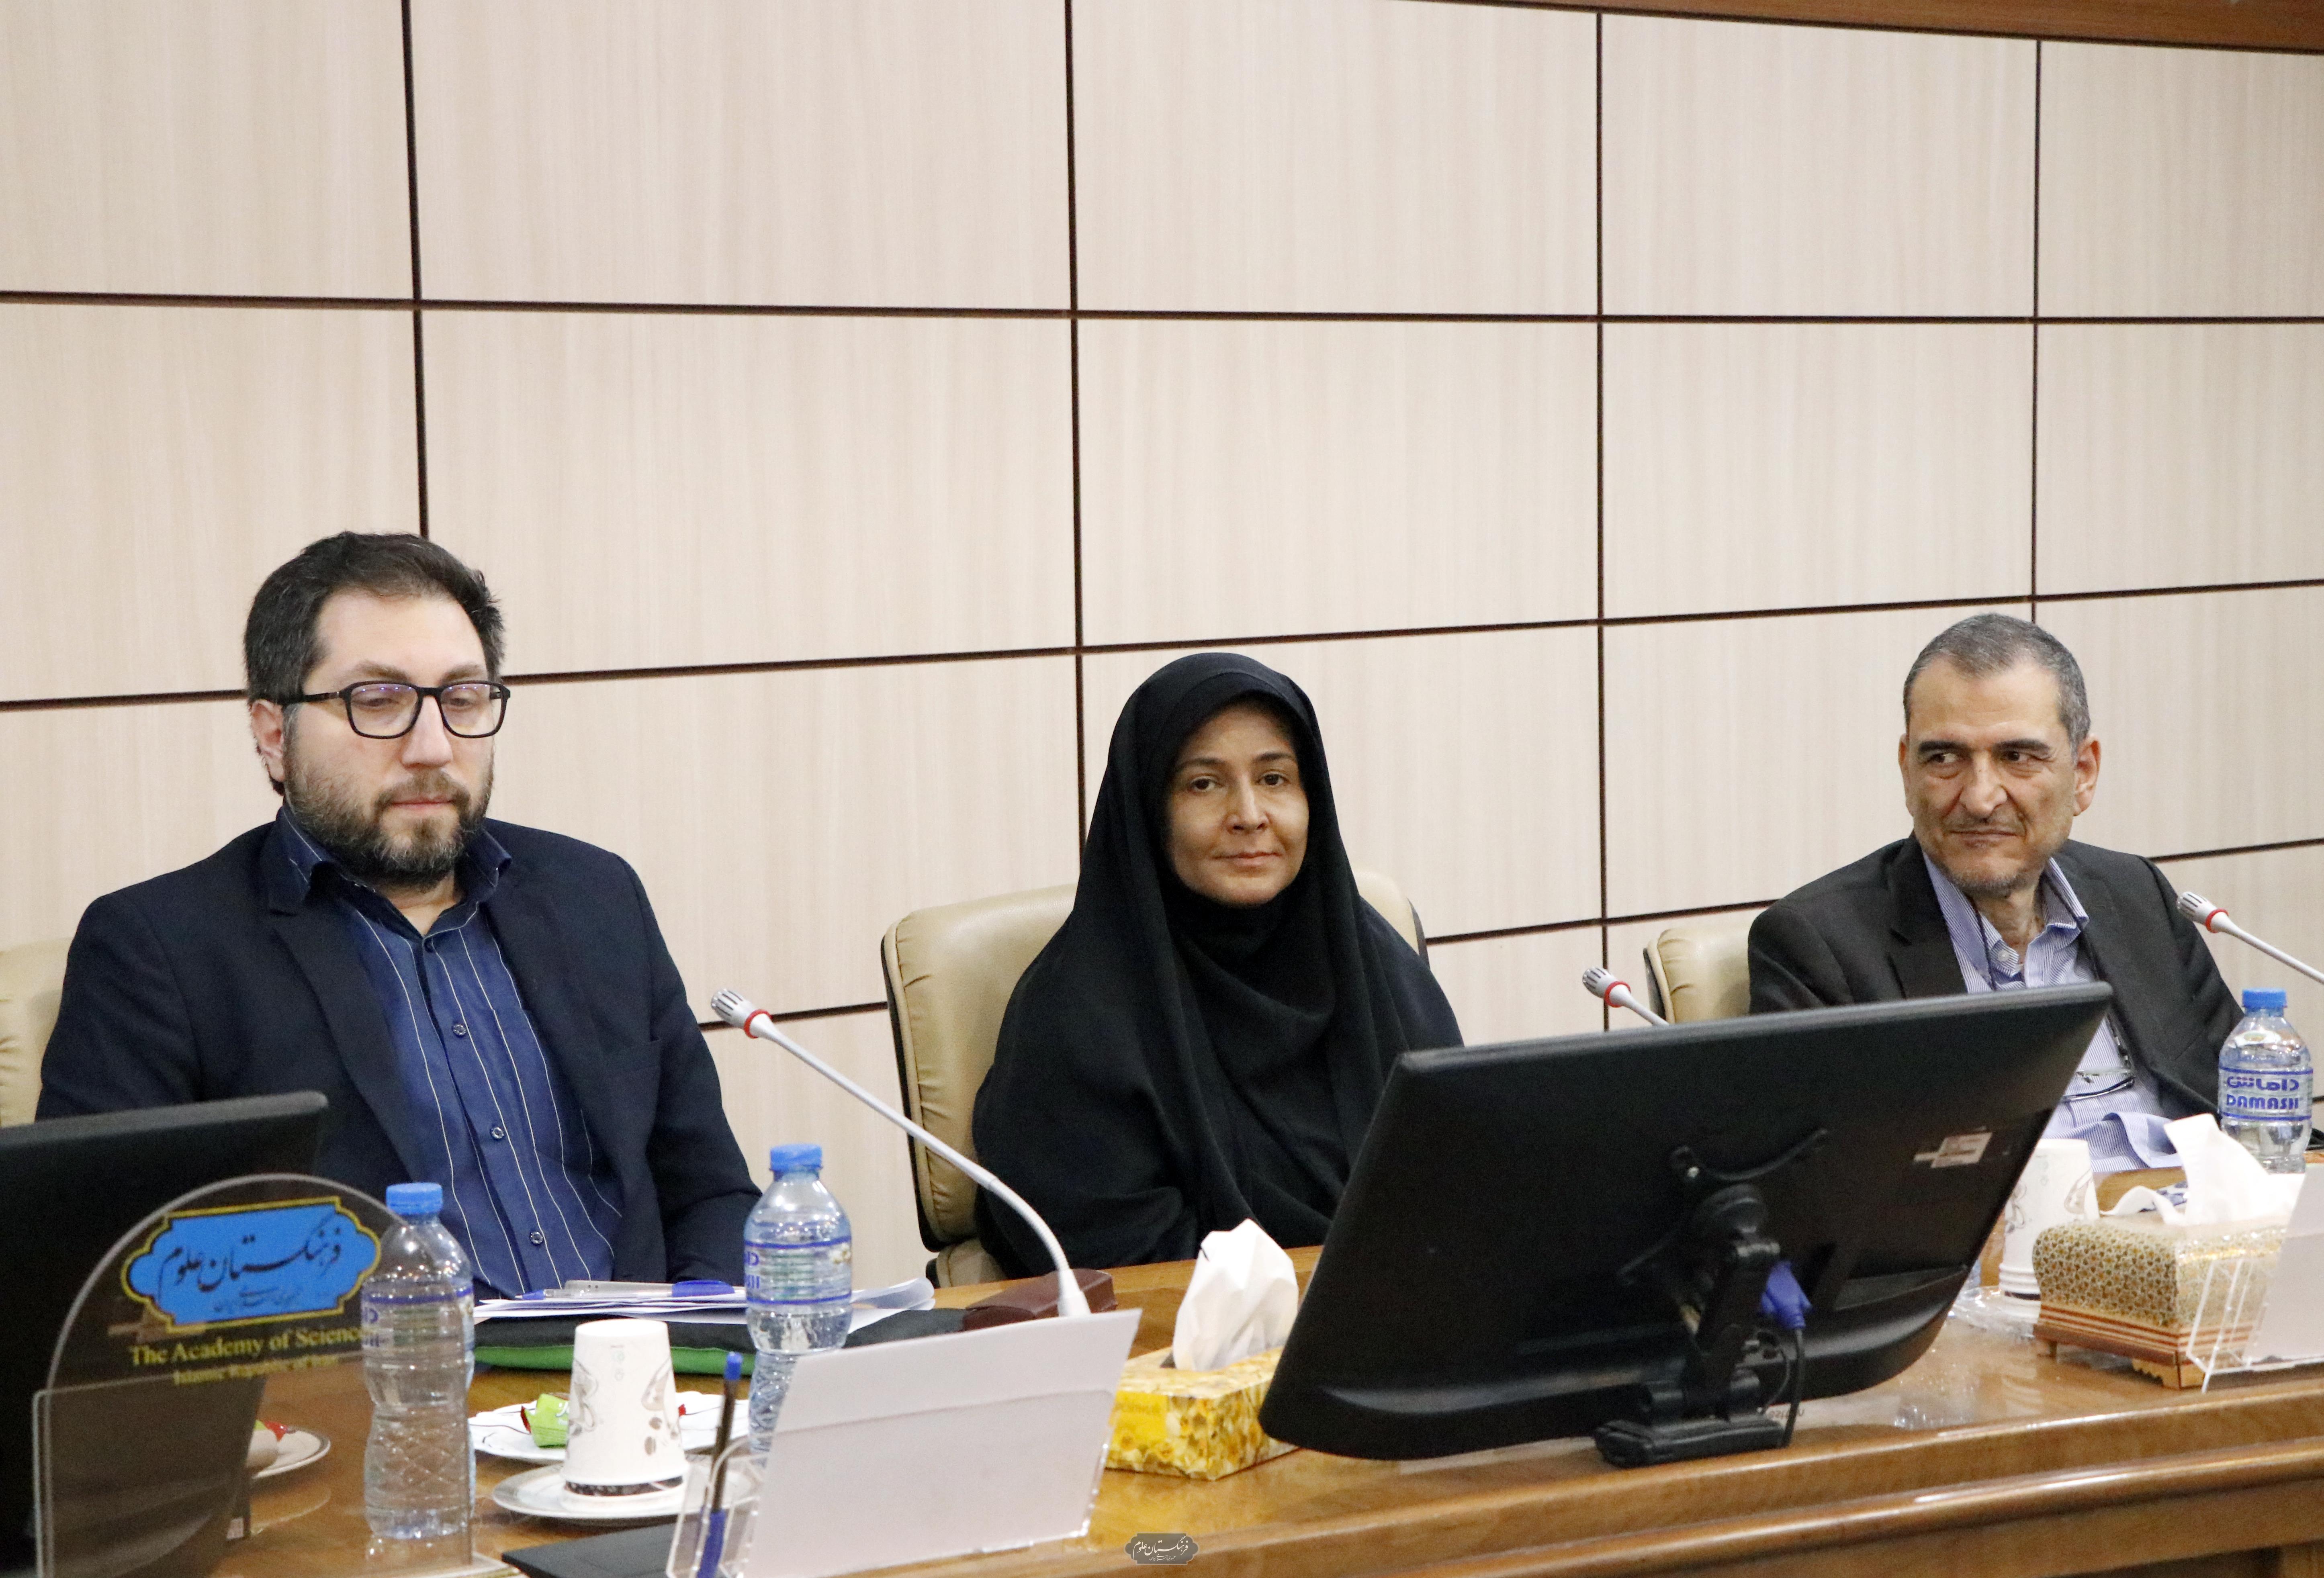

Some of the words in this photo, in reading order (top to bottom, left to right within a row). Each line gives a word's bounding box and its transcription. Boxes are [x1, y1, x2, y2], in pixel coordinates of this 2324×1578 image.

[2227, 1076, 2299, 1091] داماش
[158, 1246, 204, 1302] علوم
[197, 1208, 342, 1293] فرهنگستان
[129, 1345, 168, 1366] The
[171, 1337, 265, 1362] Academy
[269, 1328, 293, 1351] of
